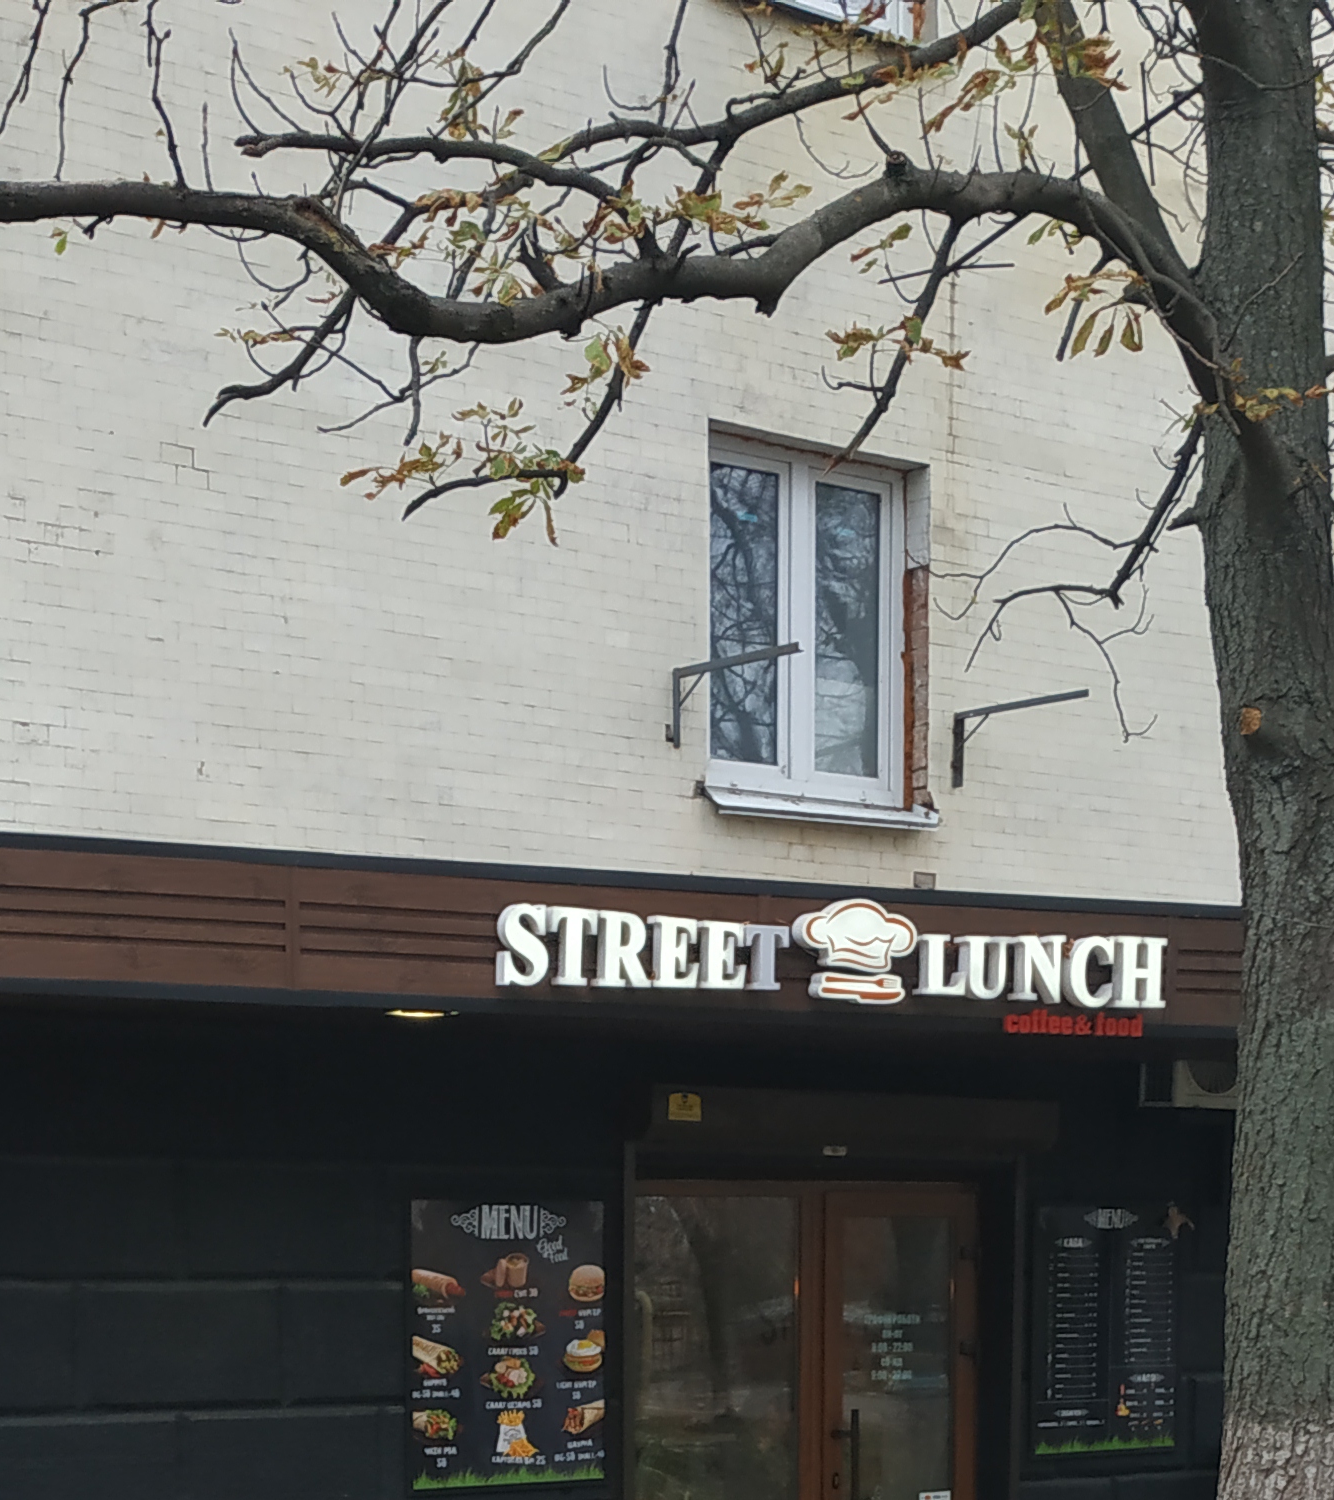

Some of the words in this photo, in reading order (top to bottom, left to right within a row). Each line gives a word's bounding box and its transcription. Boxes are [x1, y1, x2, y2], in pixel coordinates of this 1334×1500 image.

[495, 903, 789, 990] STREET
[912, 934, 1168, 1008] LUNCH
[480, 1204, 538, 1240] MENU
[1097, 1208, 1125, 1229] MENU
